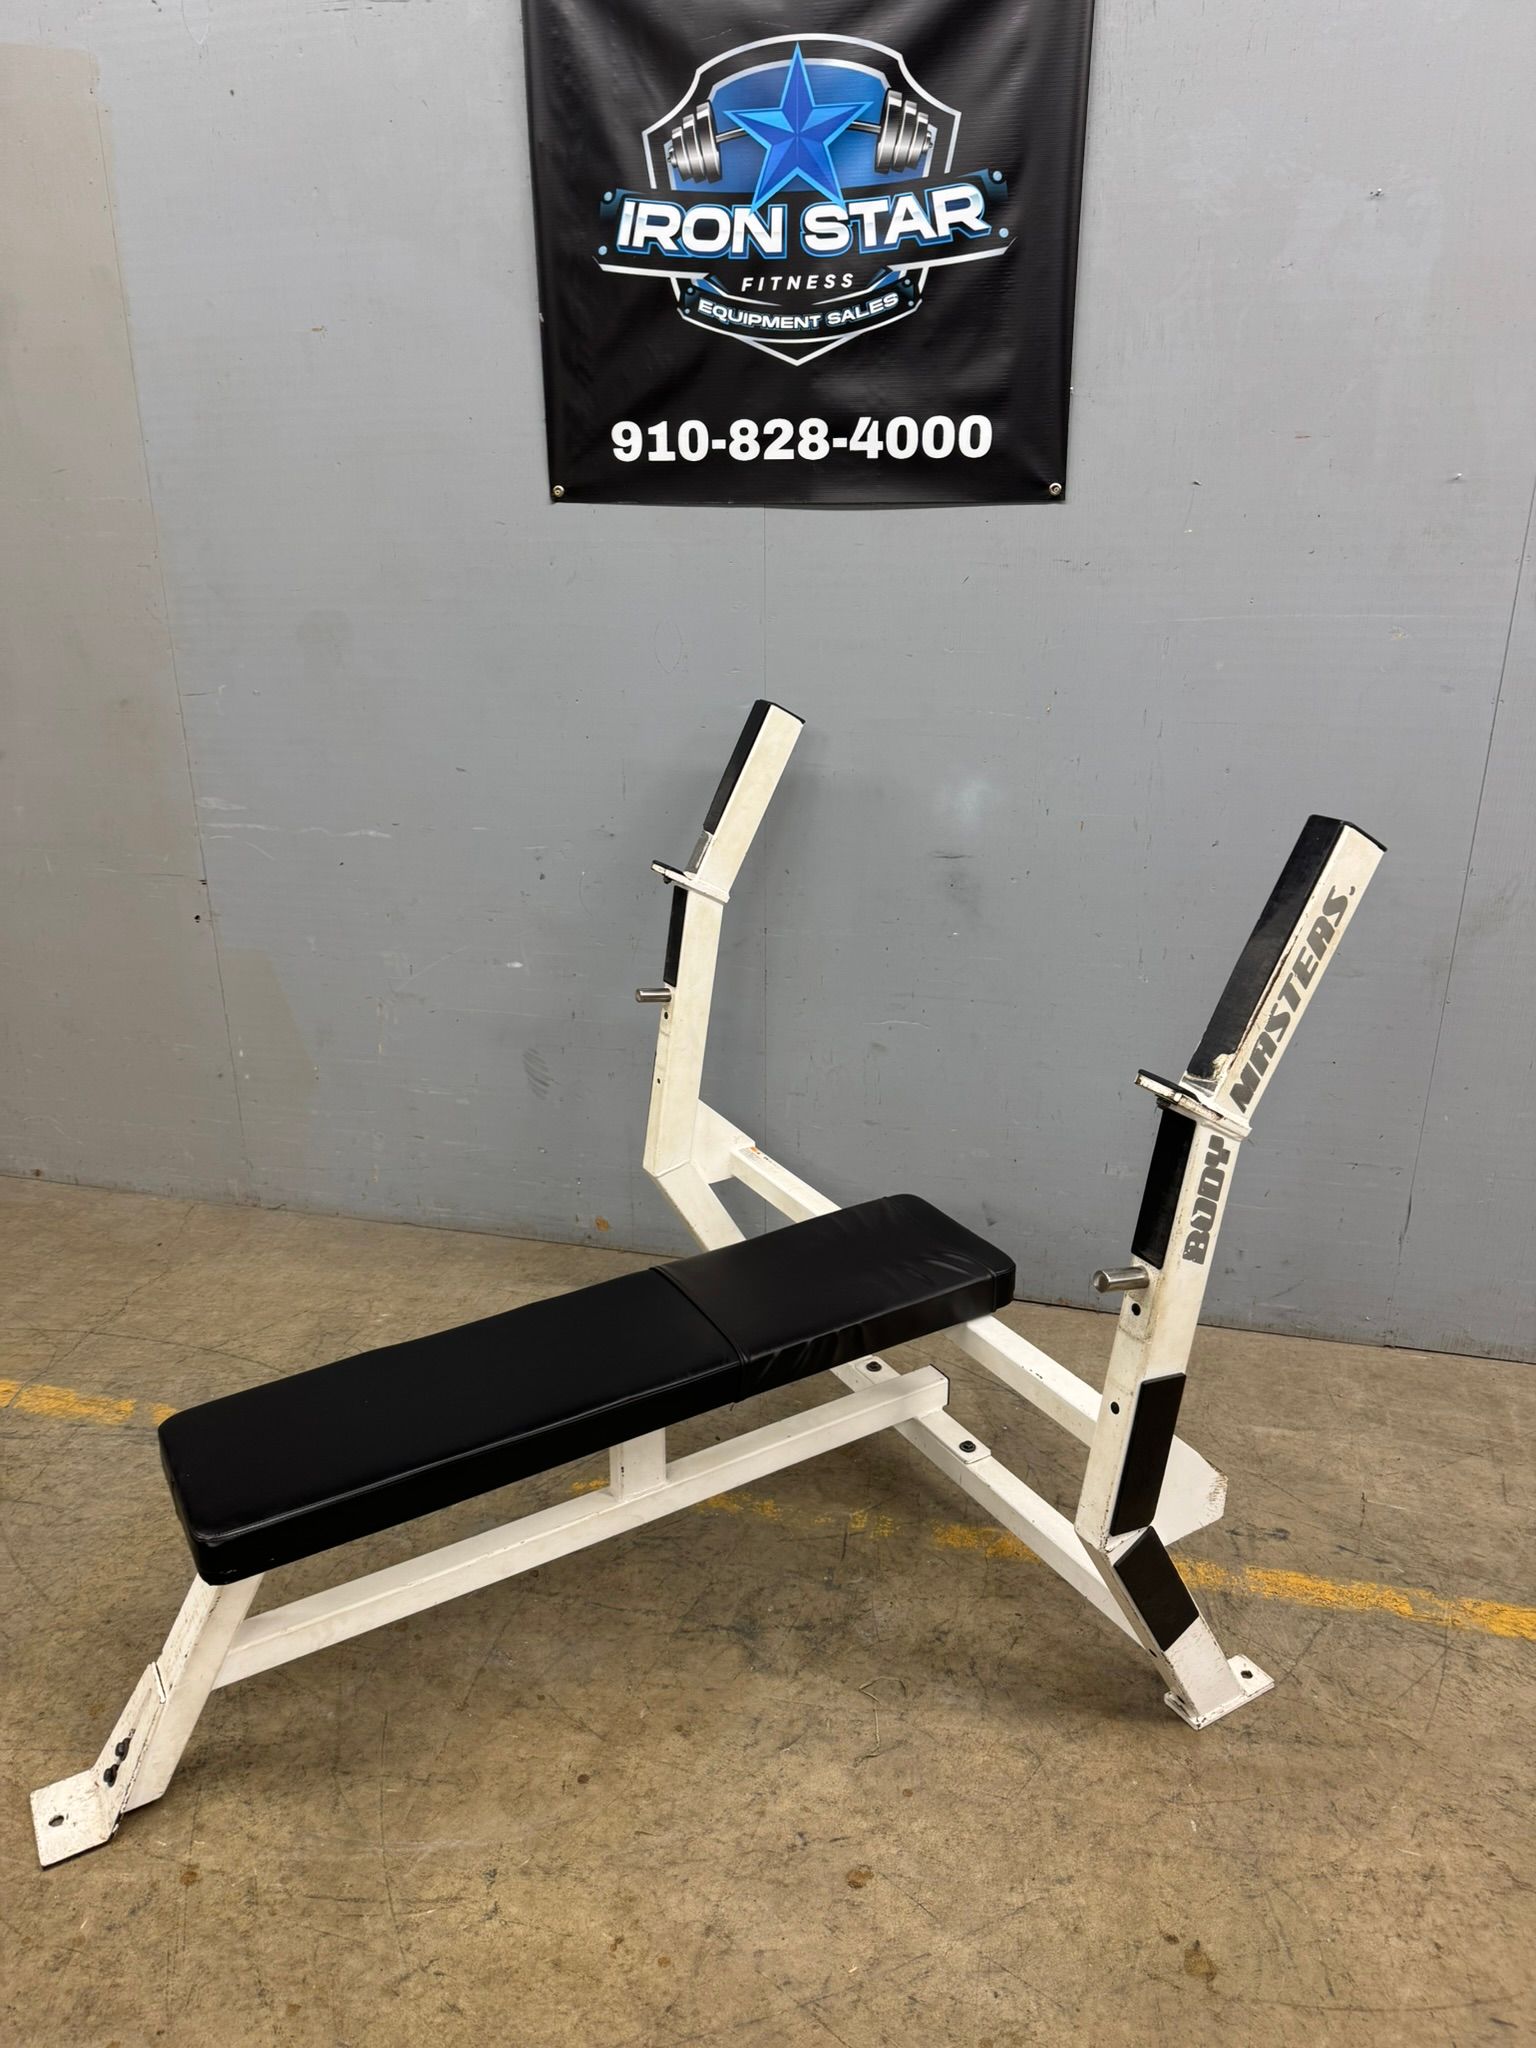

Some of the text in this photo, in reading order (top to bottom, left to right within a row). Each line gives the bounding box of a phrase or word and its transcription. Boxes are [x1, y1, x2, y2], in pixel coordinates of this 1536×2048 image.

[617, 184, 990, 255] IRON STAR
[741, 273, 854, 291] FITNESS
[698, 292, 899, 329] EQUIPMENT SALES
[611, 415, 993, 462] 910-828-4000
[1182, 1134, 1231, 1265] BODY
